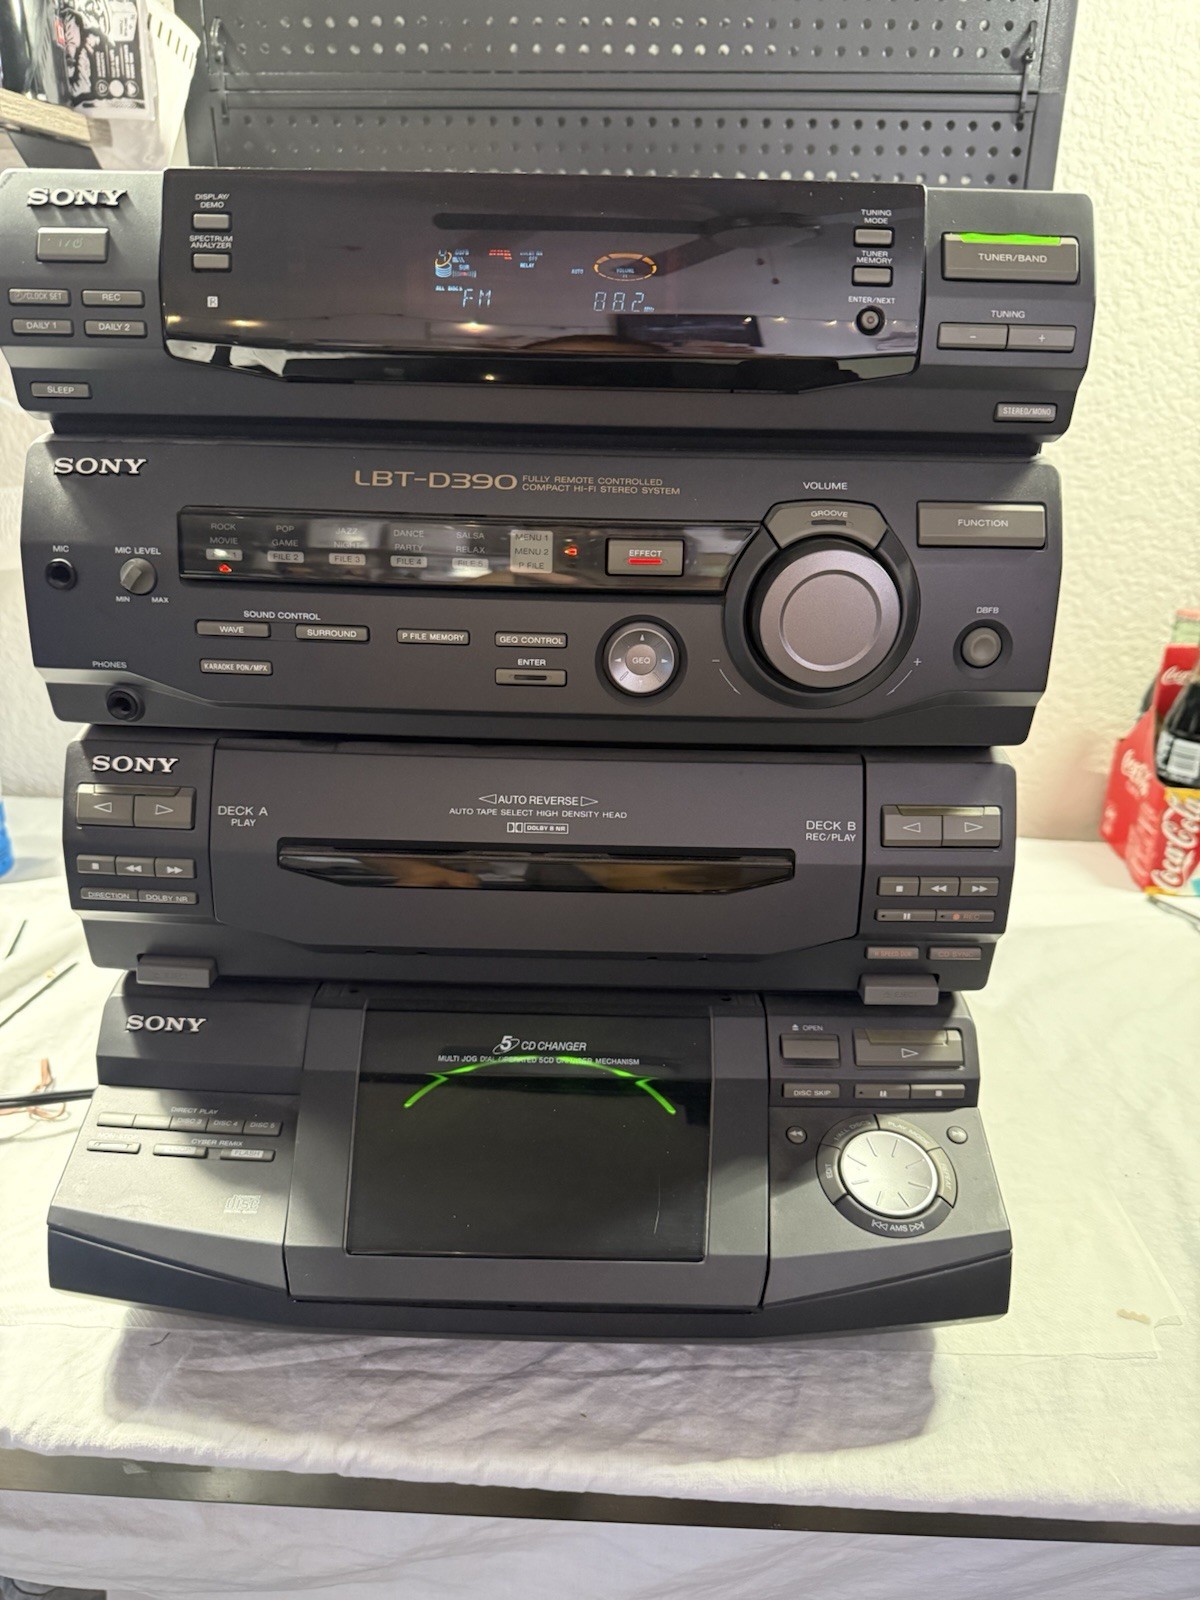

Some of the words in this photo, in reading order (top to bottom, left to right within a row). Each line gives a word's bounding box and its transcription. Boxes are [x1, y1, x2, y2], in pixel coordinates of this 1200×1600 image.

[27, 187, 127, 207] SONY
[200, 201, 225, 209] DEMO
[861, 209, 892, 217] TUNING
[864, 217, 889, 225] MODE
[189, 235, 233, 243] SPECTRUM
[190, 242, 232, 250] ANALYZER
[862, 250, 889, 258] TUNER
[978, 252, 1048, 263] TUNER/BAND
[856, 257, 893, 265] MEMORY
[49, 291, 63, 301] SET
[101, 293, 121, 302] REC
[462, 288, 492, 308] FM
[847, 296, 896, 305] ENTER/NEXT
[990, 310, 1026, 319] TUNING
[26, 321, 50, 331] DAILY
[52, 321, 58, 331] 1
[98, 322, 122, 332] DAILY
[123, 322, 131, 332] 2
[46, 385, 75, 395] SLEEP
[1002, 406, 1052, 416] STEREO/MONO
[54, 457, 147, 476] SONY
[354, 469, 518, 491] LBT-D390
[522, 475, 550, 484] FULLY
[554, 475, 594, 485] REMOTE
[597, 477, 663, 487] CONTROLLED
[522, 483, 571, 493] COMPACT
[573, 484, 598, 494] HI-FI
[600, 485, 638, 495] STEREO
[641, 486, 681, 496] SYSTEM
[803, 481, 848, 491] VOLUME
[810, 509, 848, 519] GROOVE
[957, 518, 1009, 528] FUNCTION
[210, 523, 237, 531] ROCK
[336, 527, 358, 535] JAZZ
[393, 529, 425, 538] DANCE
[456, 531, 485, 539] SALSA
[515, 533, 543, 541] MENU
[52, 545, 70, 553] MIC
[114, 546, 132, 555] MIC
[134, 546, 161, 556] LEVEL
[209, 537, 238, 545] MOVIE
[271, 539, 298, 547] GAME
[394, 543, 424, 552] PARTY
[455, 545, 486, 554] RELAX
[514, 547, 543, 556] MENU
[543, 548, 549, 556] 2
[272, 553, 292, 561] FILE
[293, 553, 299, 561] 2
[628, 549, 663, 558] EFFECT
[334, 555, 353, 563] FILE
[396, 557, 415, 566] FILE
[416, 558, 423, 566] 4
[526, 561, 545, 569] FILE
[115, 595, 131, 603] MIN
[151, 596, 169, 604] MAX
[243, 610, 276, 620] SOUND
[277, 611, 321, 621] CONTROL
[976, 606, 999, 615] DBFB
[219, 625, 245, 634] WAVE
[306, 628, 358, 639] SURROUND
[401, 632, 408, 641] P
[409, 632, 428, 642] FILE
[429, 633, 465, 643] MEMORY
[499, 635, 519, 645] GEQ
[520, 636, 564, 646] CONTROL
[92, 660, 127, 669] PHONES
[517, 658, 546, 667] ENTER
[632, 656, 651, 665] GEQ
[203, 662, 235, 672] KARAOKE
[236, 663, 269, 673] PON/MPX
[92, 755, 179, 773] SONY
[497, 795, 528, 805] AUTO
[529, 795, 579, 806] REVERSE
[217, 805, 253, 816] DECK
[258, 806, 269, 817] A
[449, 807, 474, 815] AUTO
[476, 808, 498, 816] TAPE
[500, 809, 533, 817] SELECT
[536, 809, 559, 818] HIGH
[562, 810, 600, 819] DENSITY
[602, 811, 628, 819] HEAD
[231, 818, 256, 827] PLAY
[805, 820, 841, 831] DECK
[846, 821, 857, 831] B
[805, 832, 857, 842] REC/PLAY
[87, 891, 130, 900] DIRECTION
[145, 893, 174, 902] DOLBY
[175, 895, 189, 903] NR
[126, 1014, 206, 1033] SONY
[802, 1024, 824, 1032] OPEN
[500, 1035, 512, 1050] 5
[520, 1041, 537, 1050] CD
[538, 1041, 587, 1051] CHANGER
[438, 1054, 460, 1062] MULTI
[461, 1055, 478, 1063] JOG
[538, 1056, 555, 1064] 5CD
[595, 1057, 640, 1066] MECHANISM
[793, 1089, 812, 1097] DISC
[814, 1089, 831, 1097] SKIP
[171, 1106, 198, 1115] DIRECT
[199, 1107, 219, 1116] PLAY
[213, 1119, 232, 1127] DISC
[250, 1121, 269, 1129] DISC
[191, 1138, 218, 1146] CYBER
[219, 1139, 244, 1147] REMIX
[825, 1163, 833, 1179] EDIT
[889, 1224, 908, 1233] AMS
